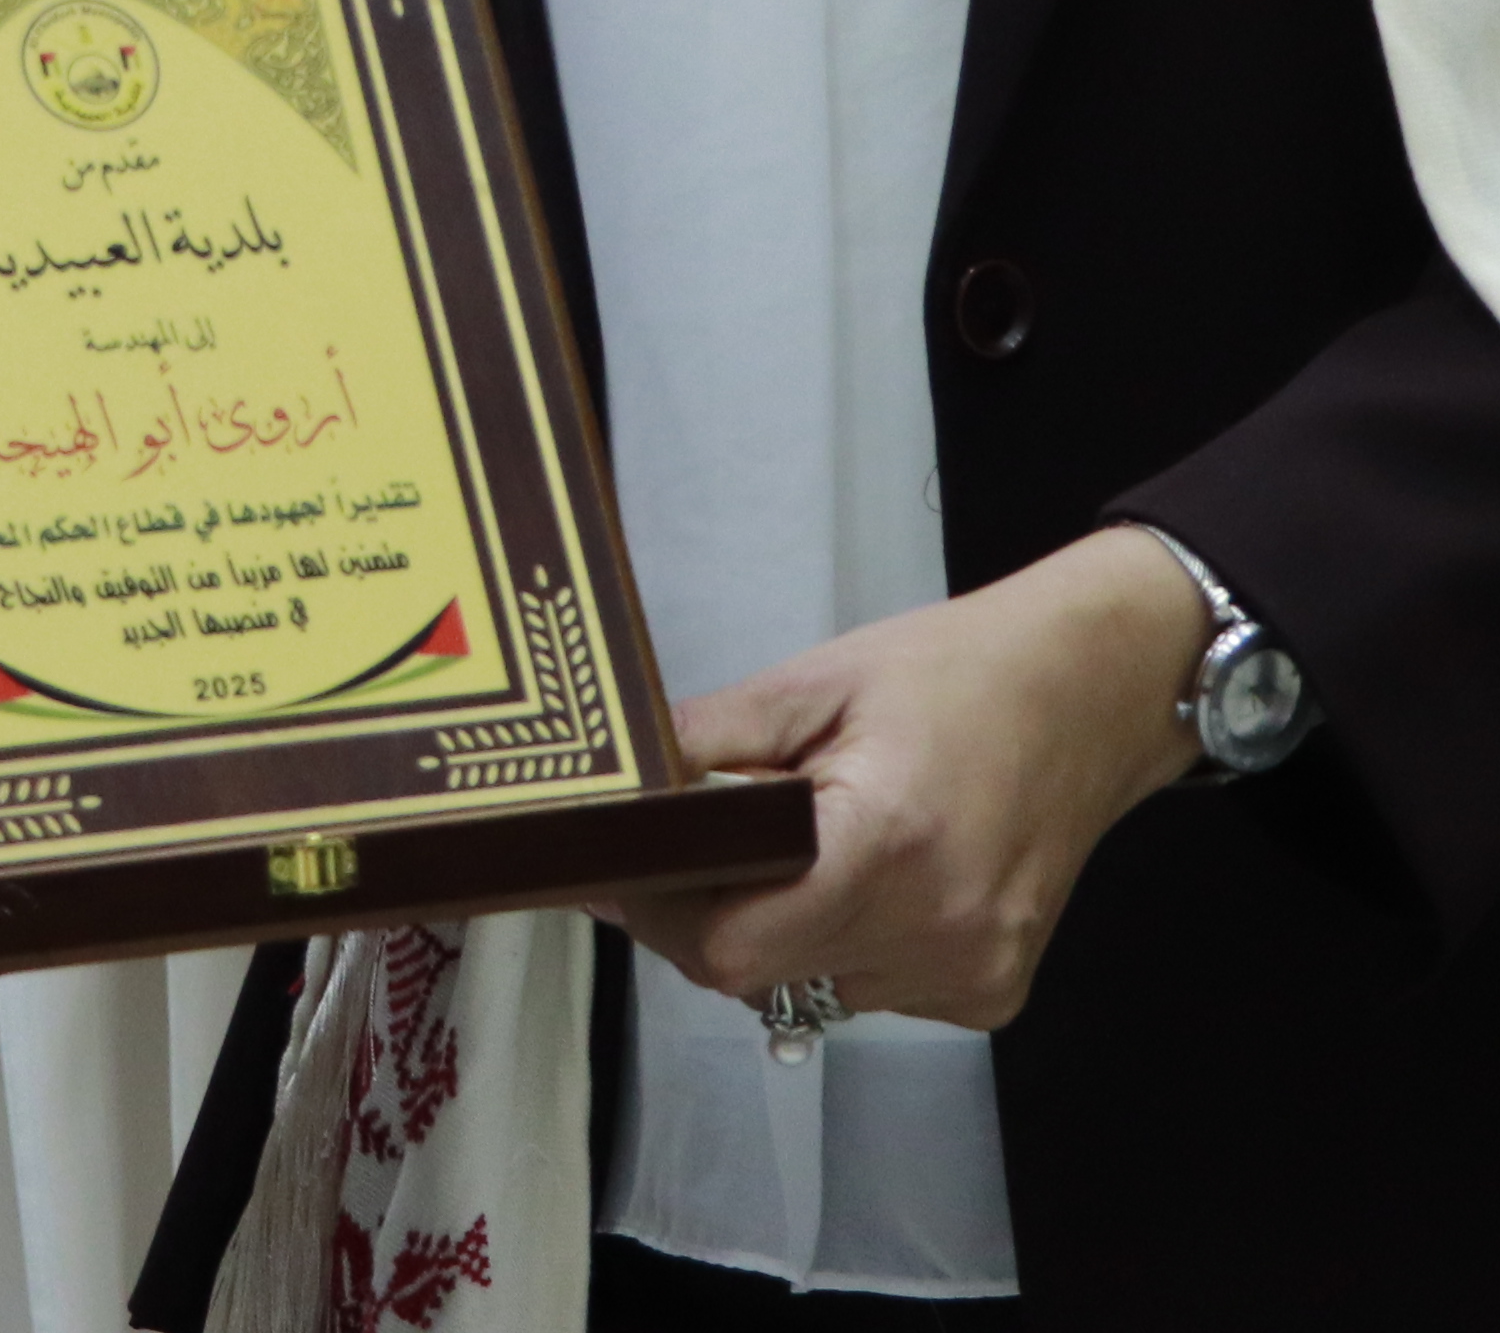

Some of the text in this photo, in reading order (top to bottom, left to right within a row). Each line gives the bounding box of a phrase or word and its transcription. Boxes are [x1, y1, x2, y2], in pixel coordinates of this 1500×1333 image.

[62, 159, 97, 191] من
[165, 195, 288, 275] بلدية
[199, 343, 358, 455] أروى
[122, 360, 192, 482] أبو
[116, 502, 186, 546] قطاع
[195, 500, 221, 543] في
[227, 492, 325, 530] لجهودها
[40, 513, 110, 551] الحكم
[187, 559, 221, 590] من
[287, 547, 330, 580] لها
[95, 564, 179, 604] التوفيق
[121, 609, 187, 650] الجديد
[191, 600, 279, 639] منصبها
[193, 672, 267, 702] 2025
